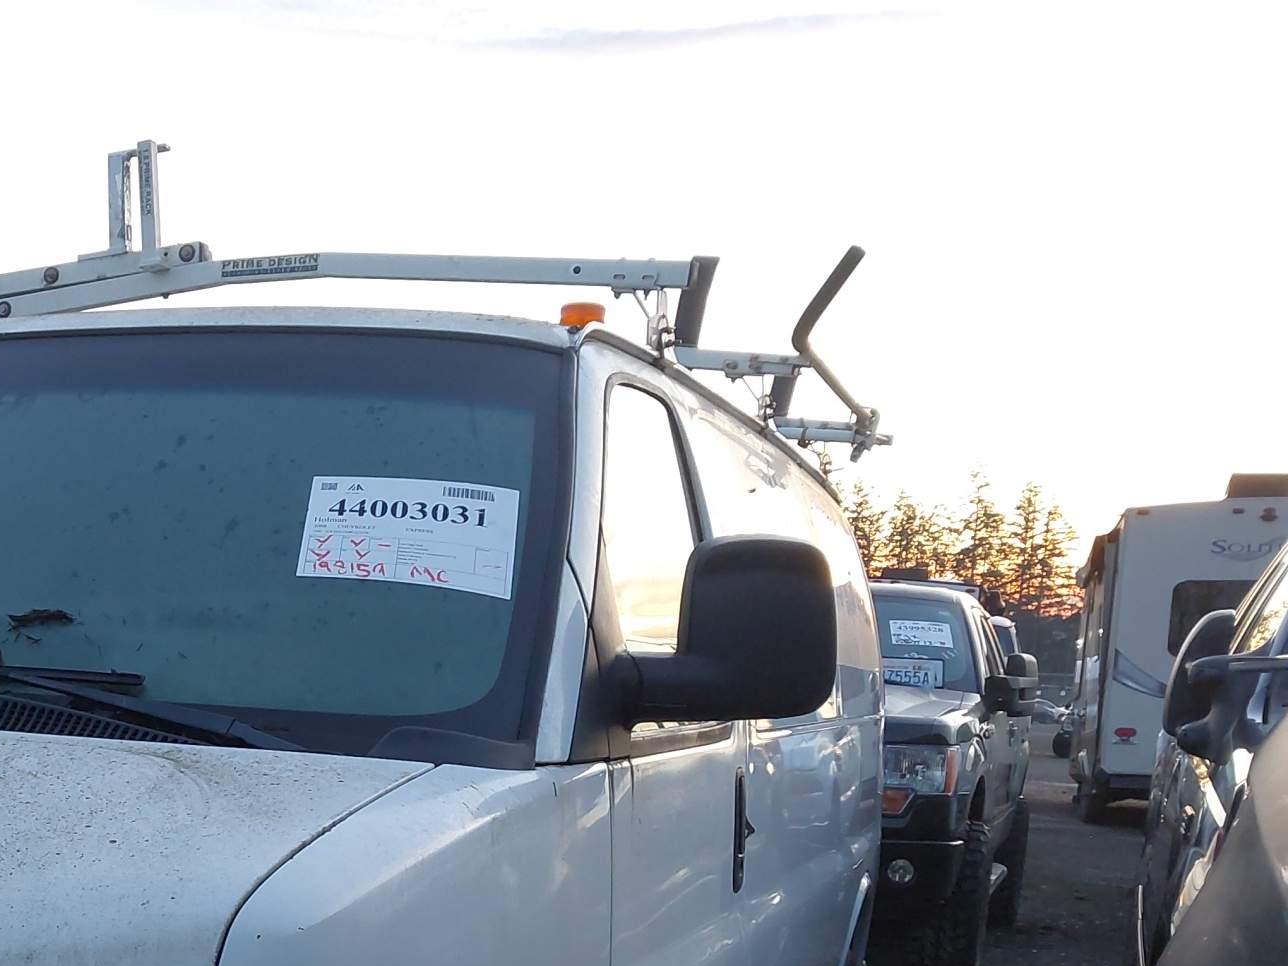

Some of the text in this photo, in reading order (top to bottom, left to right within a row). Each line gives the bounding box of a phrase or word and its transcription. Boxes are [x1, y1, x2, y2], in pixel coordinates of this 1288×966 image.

[145, 191, 153, 216] RACK
[222, 253, 319, 270] PRIME DESIGN
[328, 498, 489, 528] 44003031
